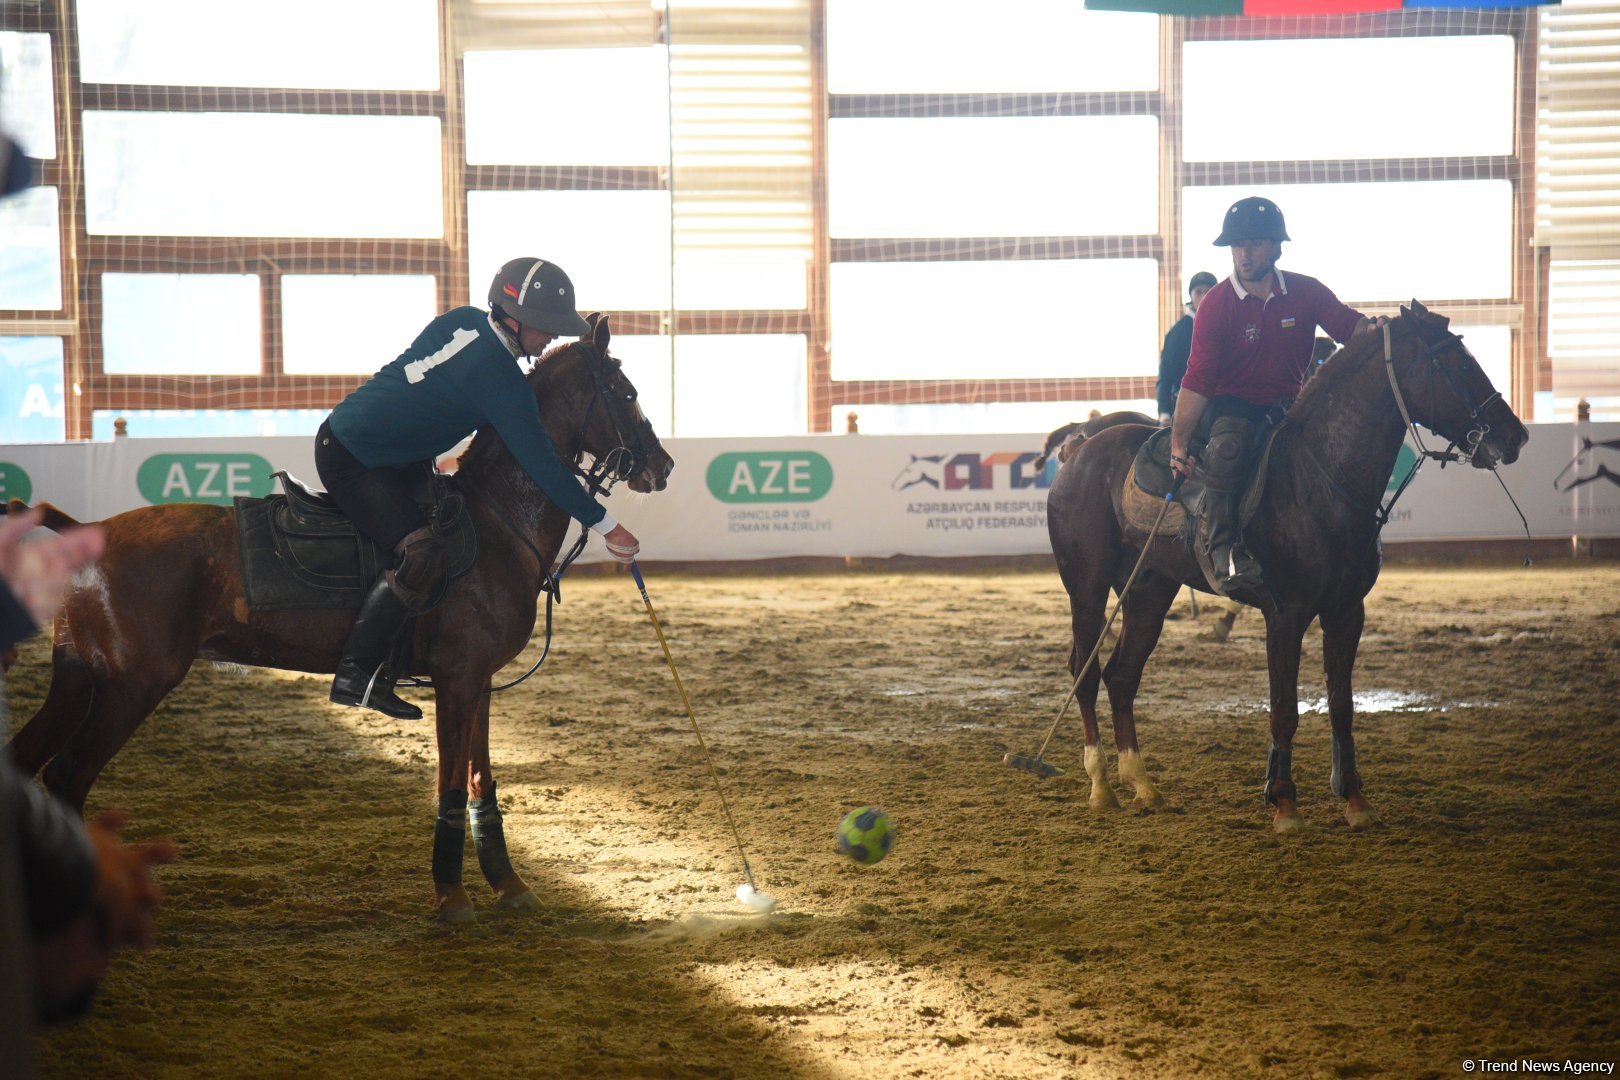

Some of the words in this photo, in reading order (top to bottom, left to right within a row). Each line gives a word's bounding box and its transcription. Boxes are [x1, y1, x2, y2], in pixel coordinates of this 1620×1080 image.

[404, 327, 480, 384] 1
[162, 463, 251, 498] AZE
[728, 460, 811, 495] AZE
[906, 502, 991, 514] AZƏRBAYCAN
[926, 518, 975, 531] ATÇILIQ
[977, 514, 1048, 529] FEDERASİY
